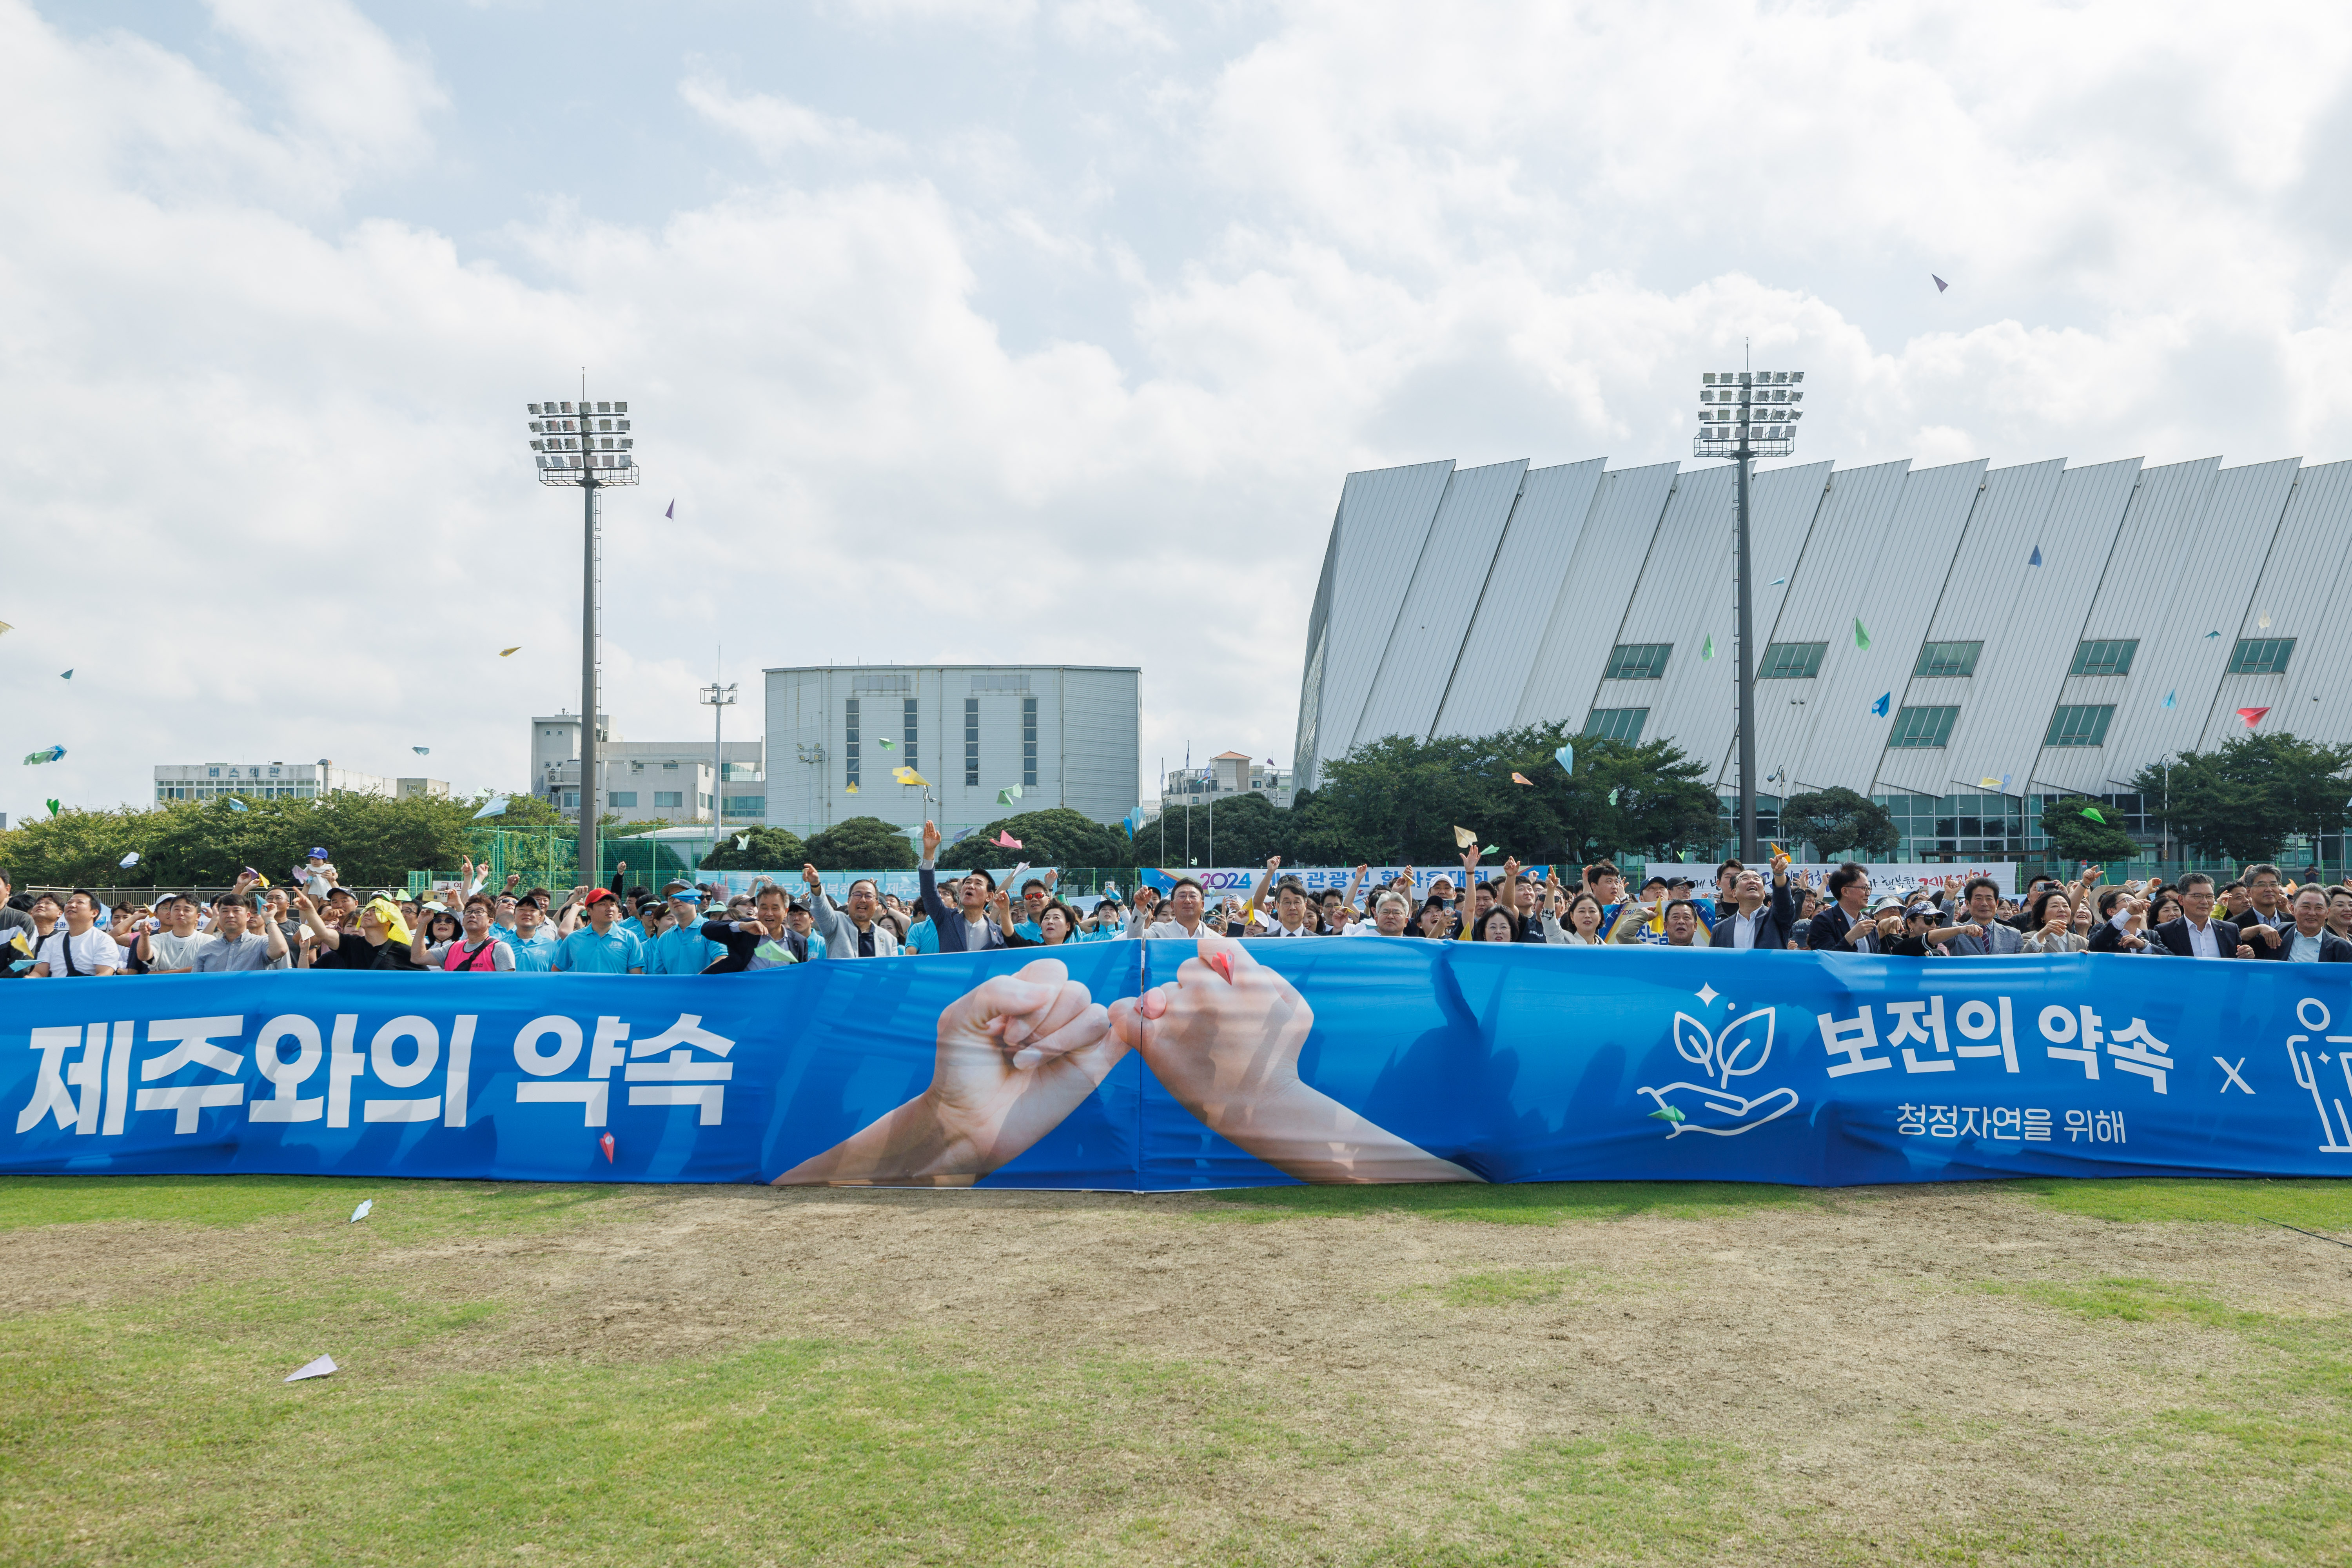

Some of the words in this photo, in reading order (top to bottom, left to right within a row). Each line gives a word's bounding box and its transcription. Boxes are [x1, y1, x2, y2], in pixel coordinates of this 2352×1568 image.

[1200, 872, 1252, 889] 2024
[16, 1014, 478, 1136] 제주와의
[514, 1013, 736, 1127] 약속
[1817, 995, 2020, 1078] 보전의
[2038, 1004, 2174, 1095] 약속
[1896, 1102, 2053, 1142] 청정자연을
[2063, 1109, 2127, 1144] 위해
